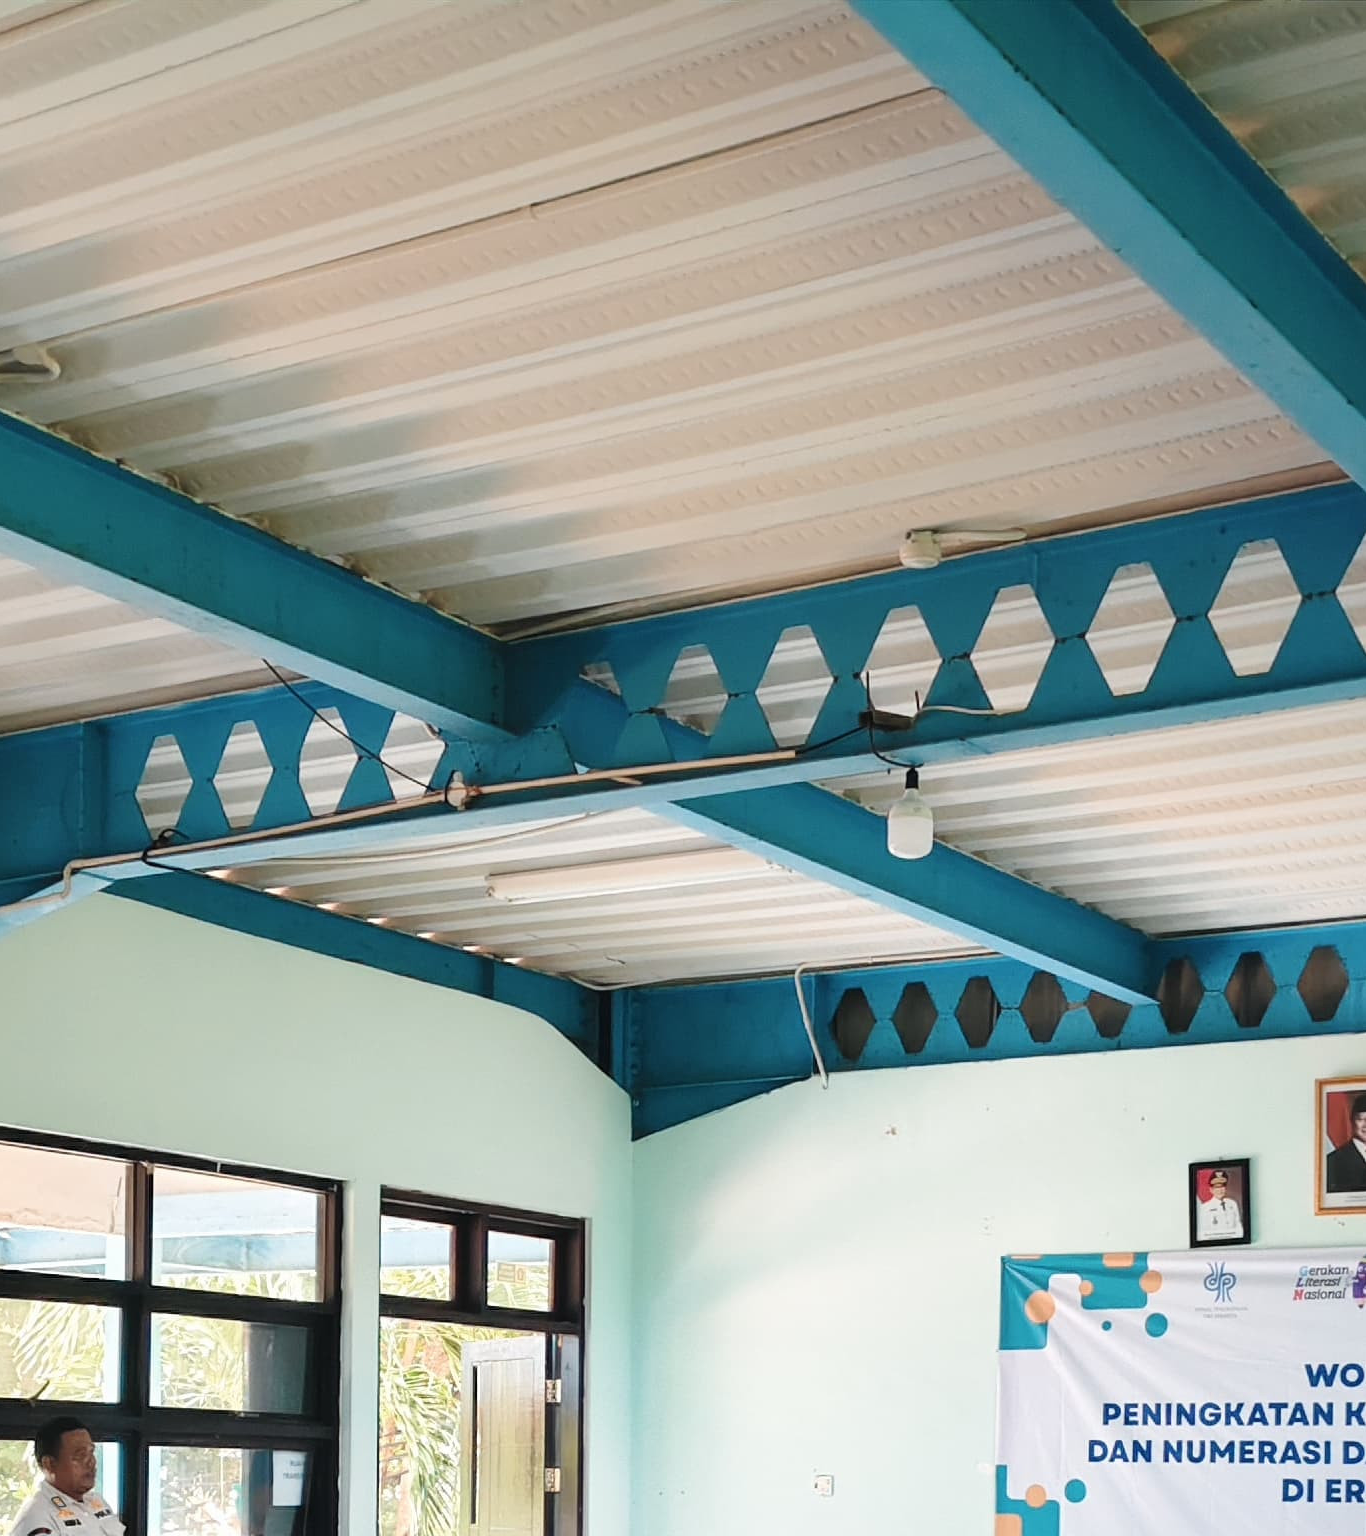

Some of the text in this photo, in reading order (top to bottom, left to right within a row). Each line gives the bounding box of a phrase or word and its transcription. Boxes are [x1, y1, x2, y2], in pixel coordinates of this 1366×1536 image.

[1299, 1264, 1350, 1277] Gerakan
[1295, 1277, 1341, 1288] Literasi
[1293, 1288, 1347, 1301] Nasional
[1102, 1402, 1334, 1427] PENINGKATAN
[1088, 1439, 1152, 1464] DAN
[1163, 1440, 1332, 1465] NUMERASI
[1282, 1479, 1314, 1503] DI
